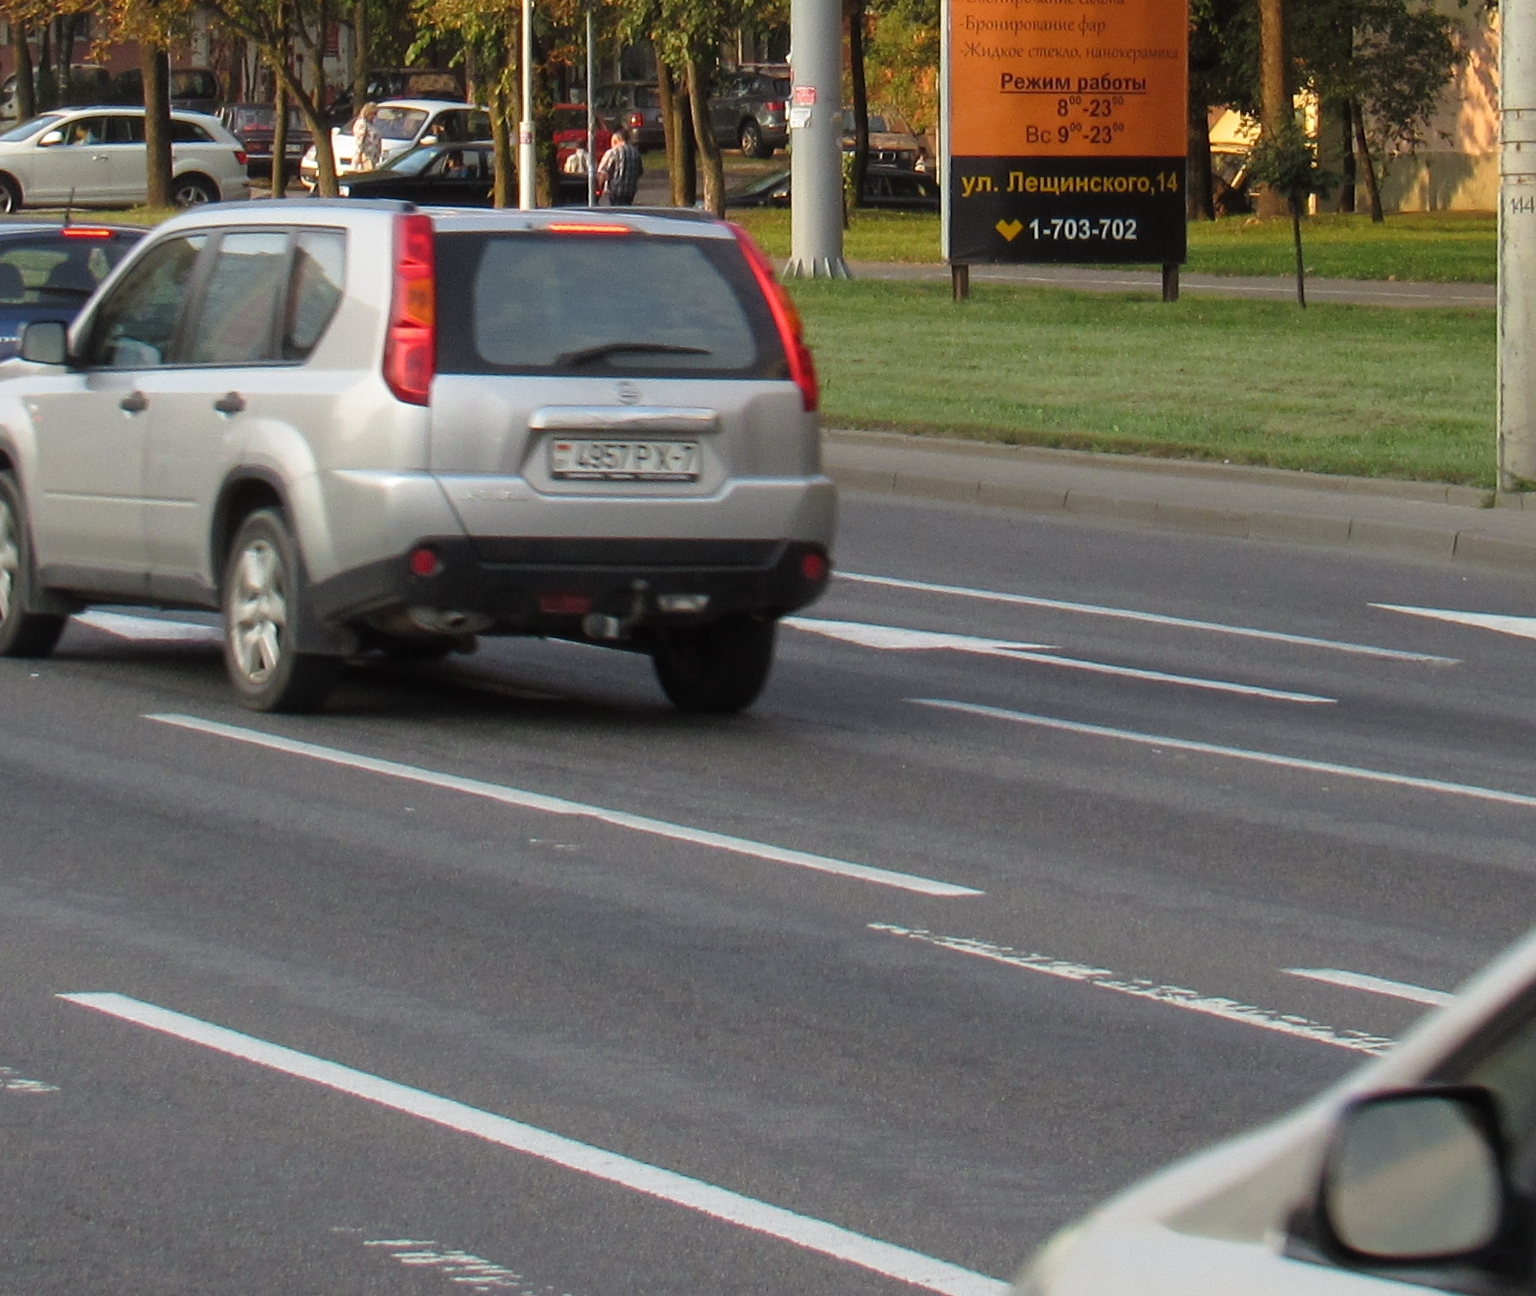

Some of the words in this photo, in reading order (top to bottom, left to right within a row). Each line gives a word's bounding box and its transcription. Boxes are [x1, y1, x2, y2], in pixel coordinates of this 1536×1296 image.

[1078, 14, 1107, 37] фар
[1000, 72, 1071, 91] Режим
[1076, 73, 1147, 95] работы
[1026, 125, 1052, 144] Вс
[960, 176, 999, 198] ул.
[1029, 218, 1138, 241] 1-703-702
